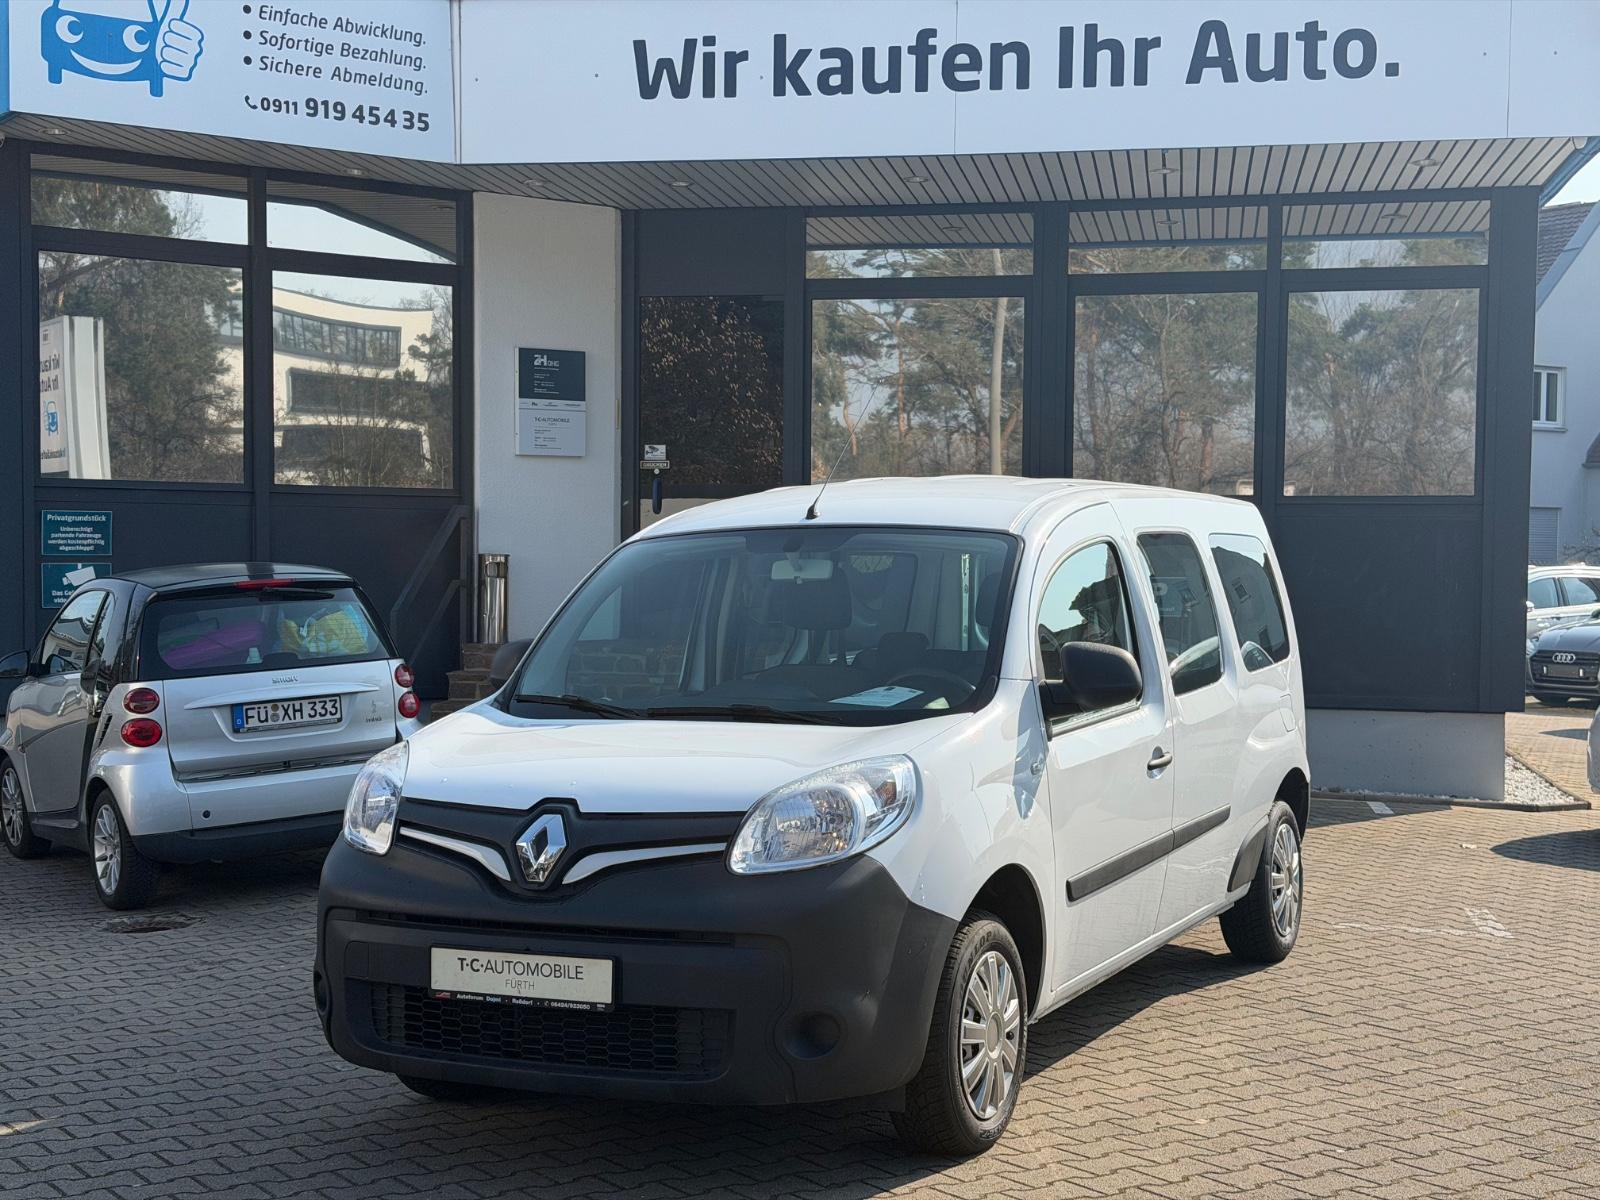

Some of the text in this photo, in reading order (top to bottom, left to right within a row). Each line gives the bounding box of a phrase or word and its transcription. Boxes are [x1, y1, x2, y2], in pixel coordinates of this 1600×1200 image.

[258, 4, 427, 48] Einfache Abwicklung.
[258, 30, 427, 72] Sofortige Bezahlung.
[633, 20, 1399, 100] Wir kaufen Ihr Auto.
[258, 55, 428, 97] Sichere Abmeldung.
[260, 97, 430, 132] 0911 919 454 35
[47, 514, 106, 522] Privatgrundstück
[245, 705, 269, 725] FÜ
[281, 702, 304, 721] XH
[308, 699, 338, 719] 333
[505, 978, 535, 991] FÜRTH
